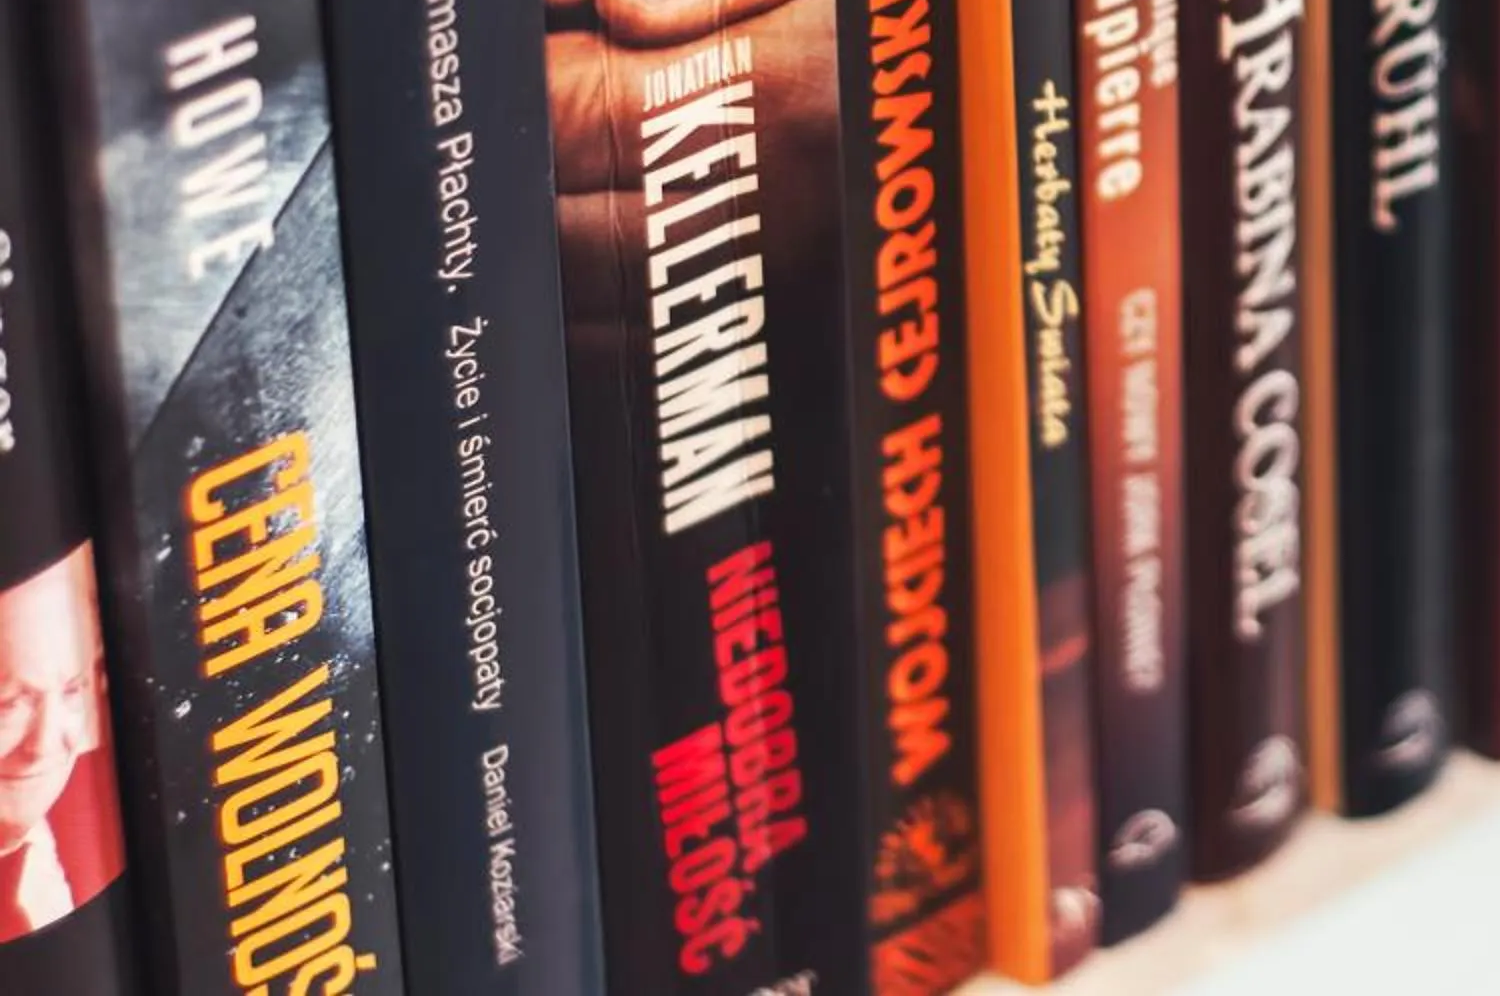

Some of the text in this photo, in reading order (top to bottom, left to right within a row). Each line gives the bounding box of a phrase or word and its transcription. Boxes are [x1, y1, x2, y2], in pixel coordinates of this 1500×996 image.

[163, 13, 276, 282] HOWE
[643, 35, 753, 112] JONATHAN
[1025, 78, 1072, 274] Herbaty
[447, 317, 489, 408] Życie
[640, 80, 775, 536] KELLERMAN
[188, 428, 325, 678] CENA
[458, 434, 493, 547] śmierć
[881, 412, 949, 787] WOJCIECH
[466, 556, 504, 712] socjopaty
[706, 540, 808, 874] NIEDOBRA
[480, 743, 513, 835] Daniel
[650, 722, 761, 975] MIŁOŚĆ
